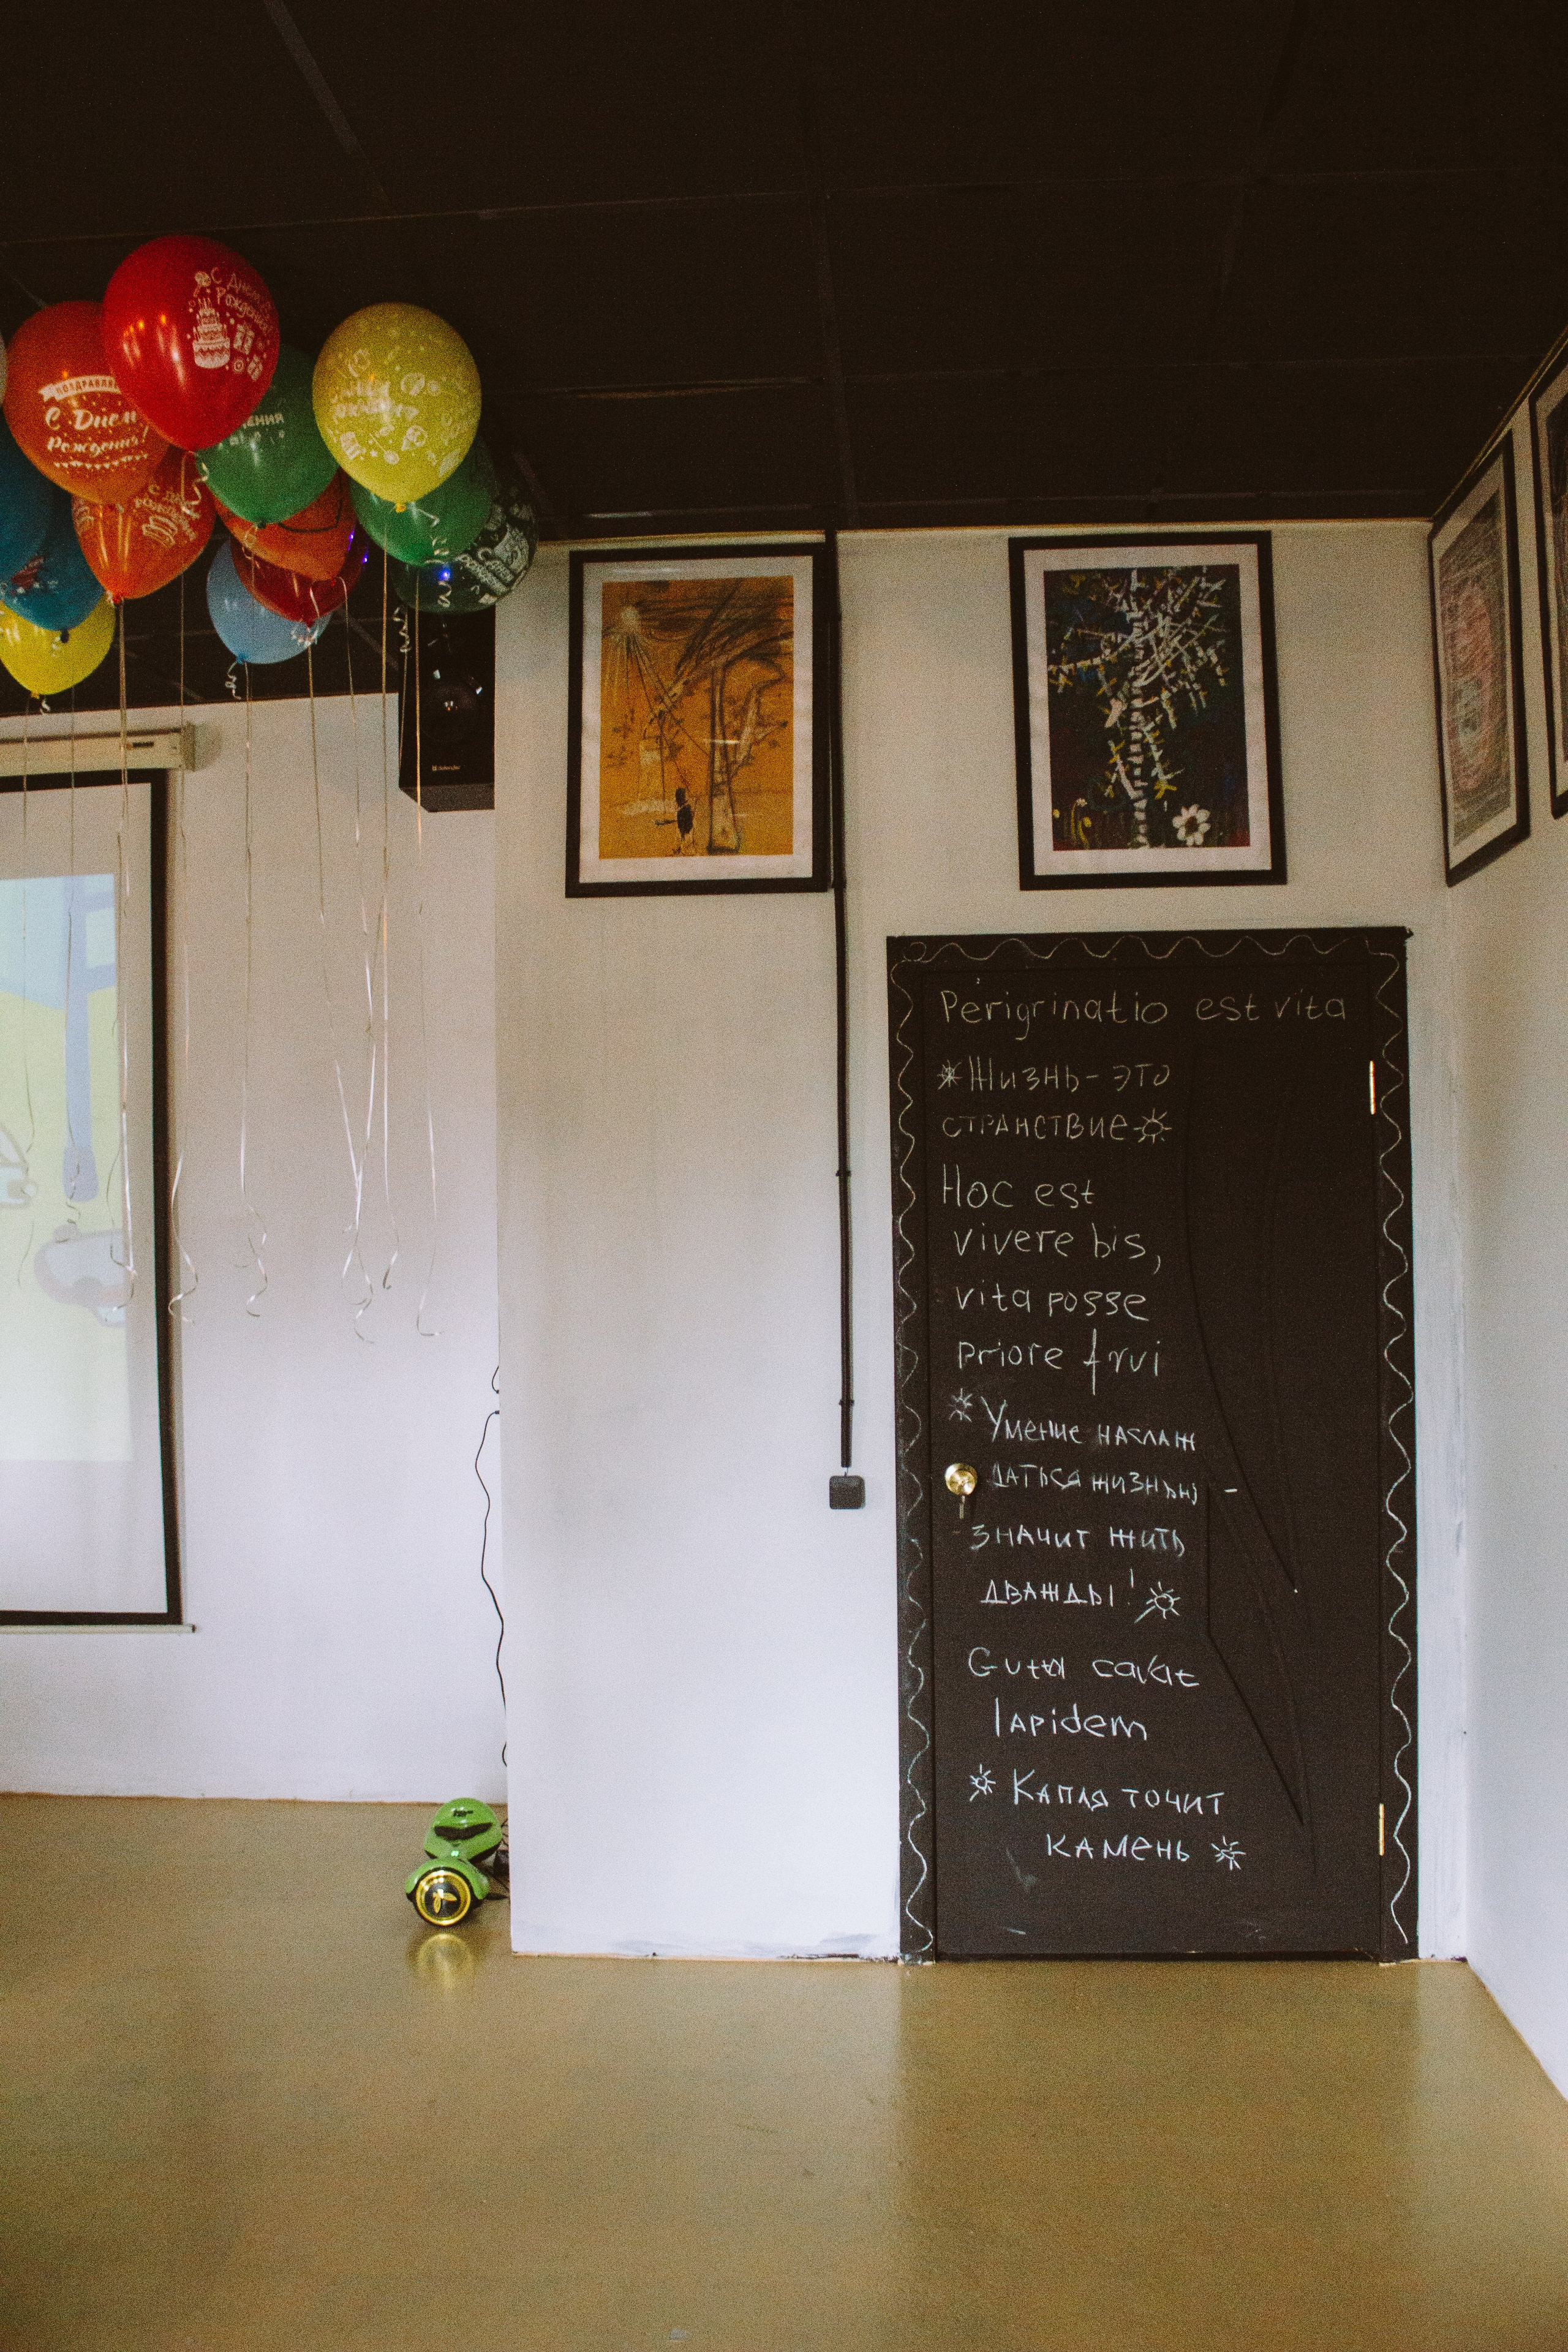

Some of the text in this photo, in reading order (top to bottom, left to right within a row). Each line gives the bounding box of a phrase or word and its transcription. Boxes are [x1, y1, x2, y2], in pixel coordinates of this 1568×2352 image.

[45, 407, 61, 430] С
[941, 990, 1346, 1041] Perigrinatio est vita
[943, 1164, 1095, 1210] Hoc est
[954, 1223, 1074, 1257] vivere
[956, 1280, 1149, 1322] vita posse
[957, 1329, 1161, 1395] priore frui
